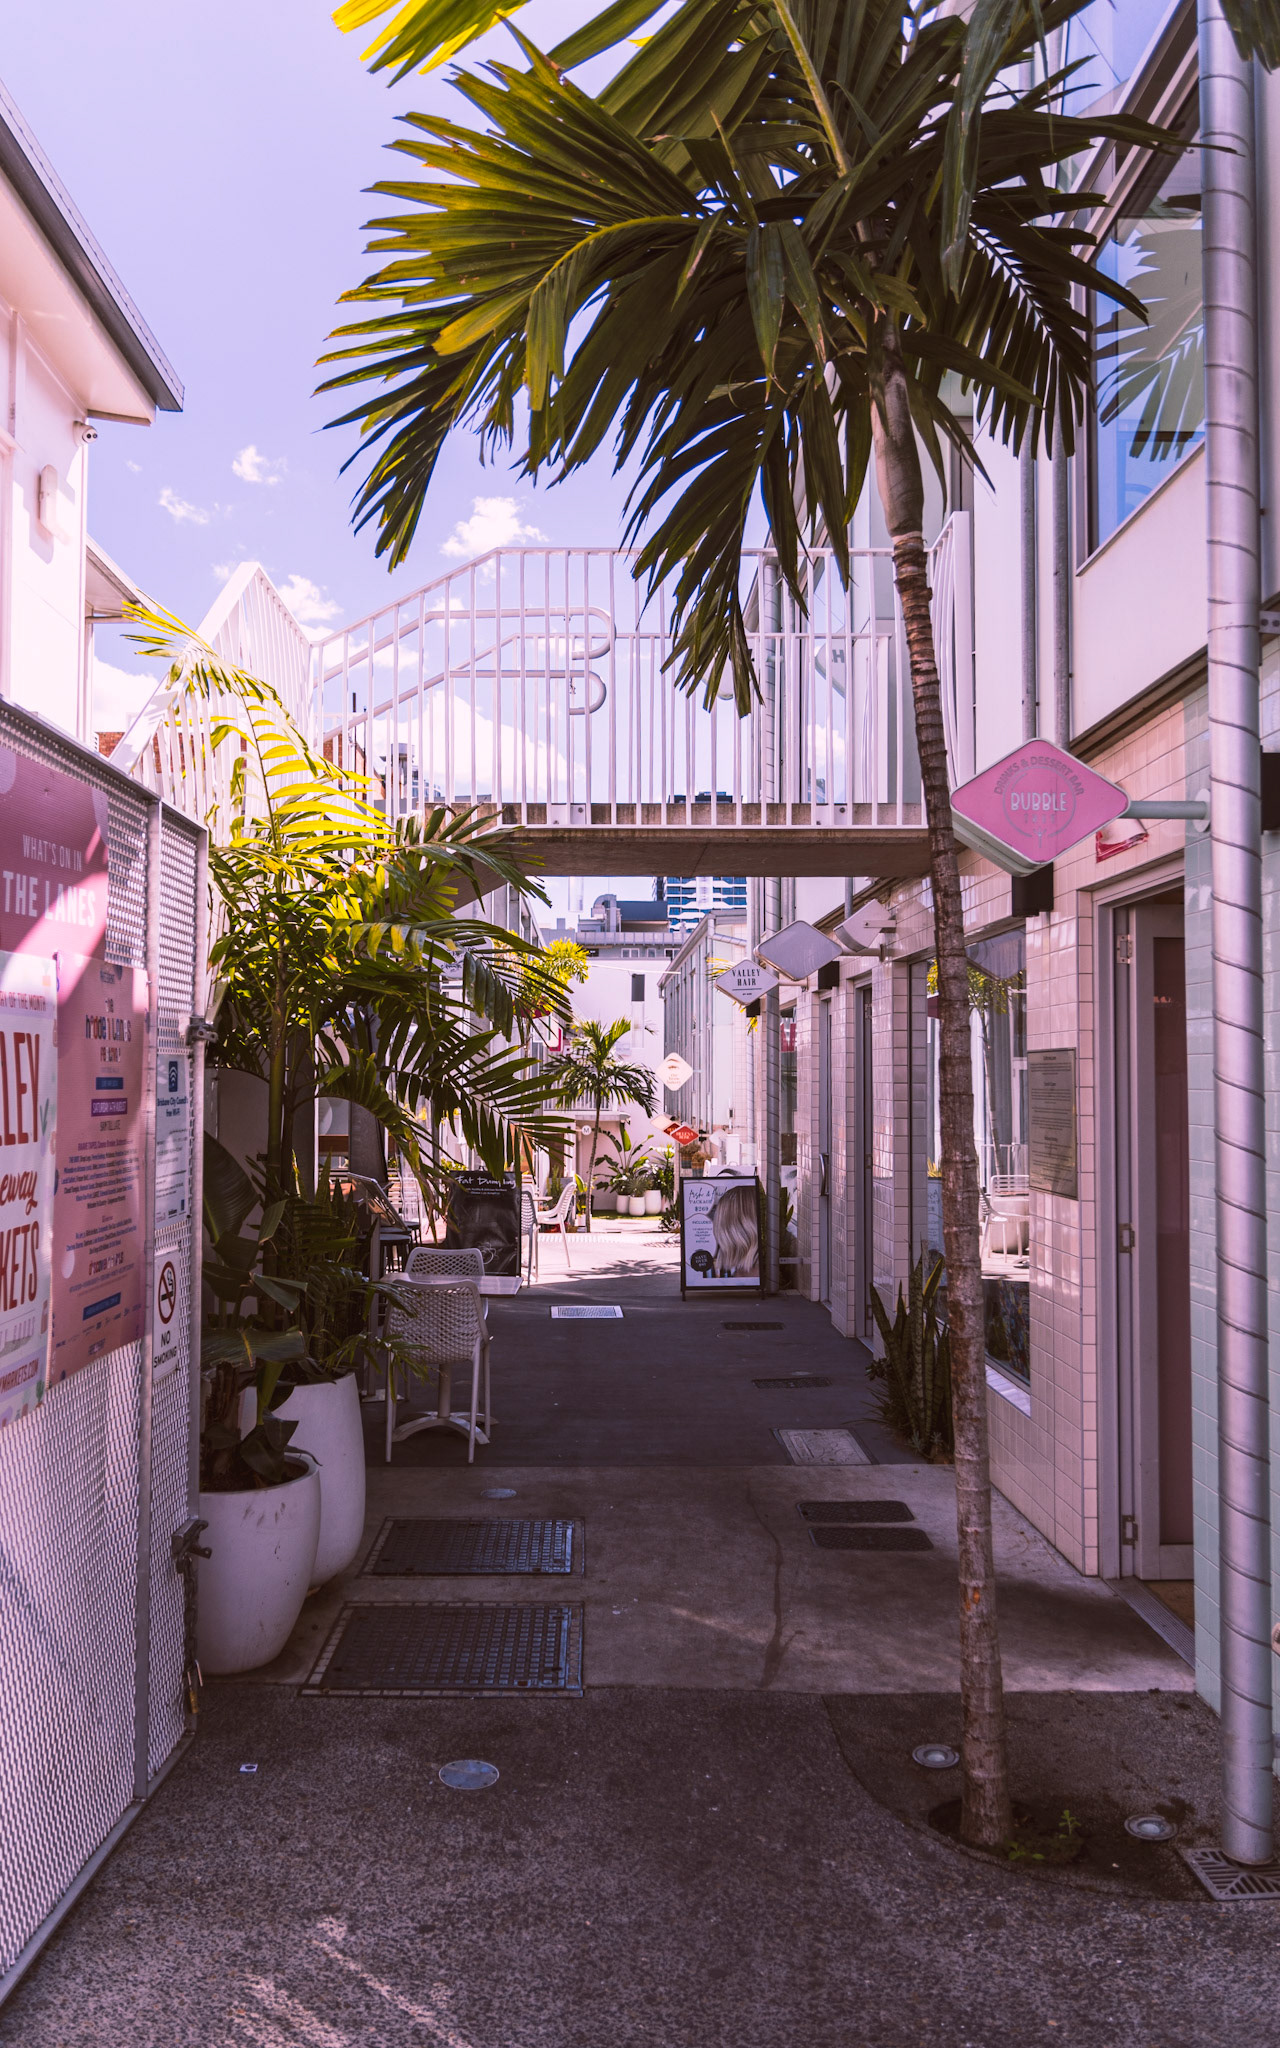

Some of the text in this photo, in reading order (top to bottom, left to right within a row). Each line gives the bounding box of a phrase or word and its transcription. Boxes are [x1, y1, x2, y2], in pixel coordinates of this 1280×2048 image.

[994, 756, 1085, 796] DRINKS & DESSERT BAR
[1010, 792, 1067, 811] BUBBLE
[22, 834, 82, 872] WHAT'S ON IN
[2, 870, 96, 928] THE LANES
[732, 968, 761, 977] VALLEY
[737, 977, 757, 986] HAIR
[455, 1175, 474, 1185] Fat
[161, 1330, 171, 1348] NO
[153, 1346, 177, 1368] SMOKING
